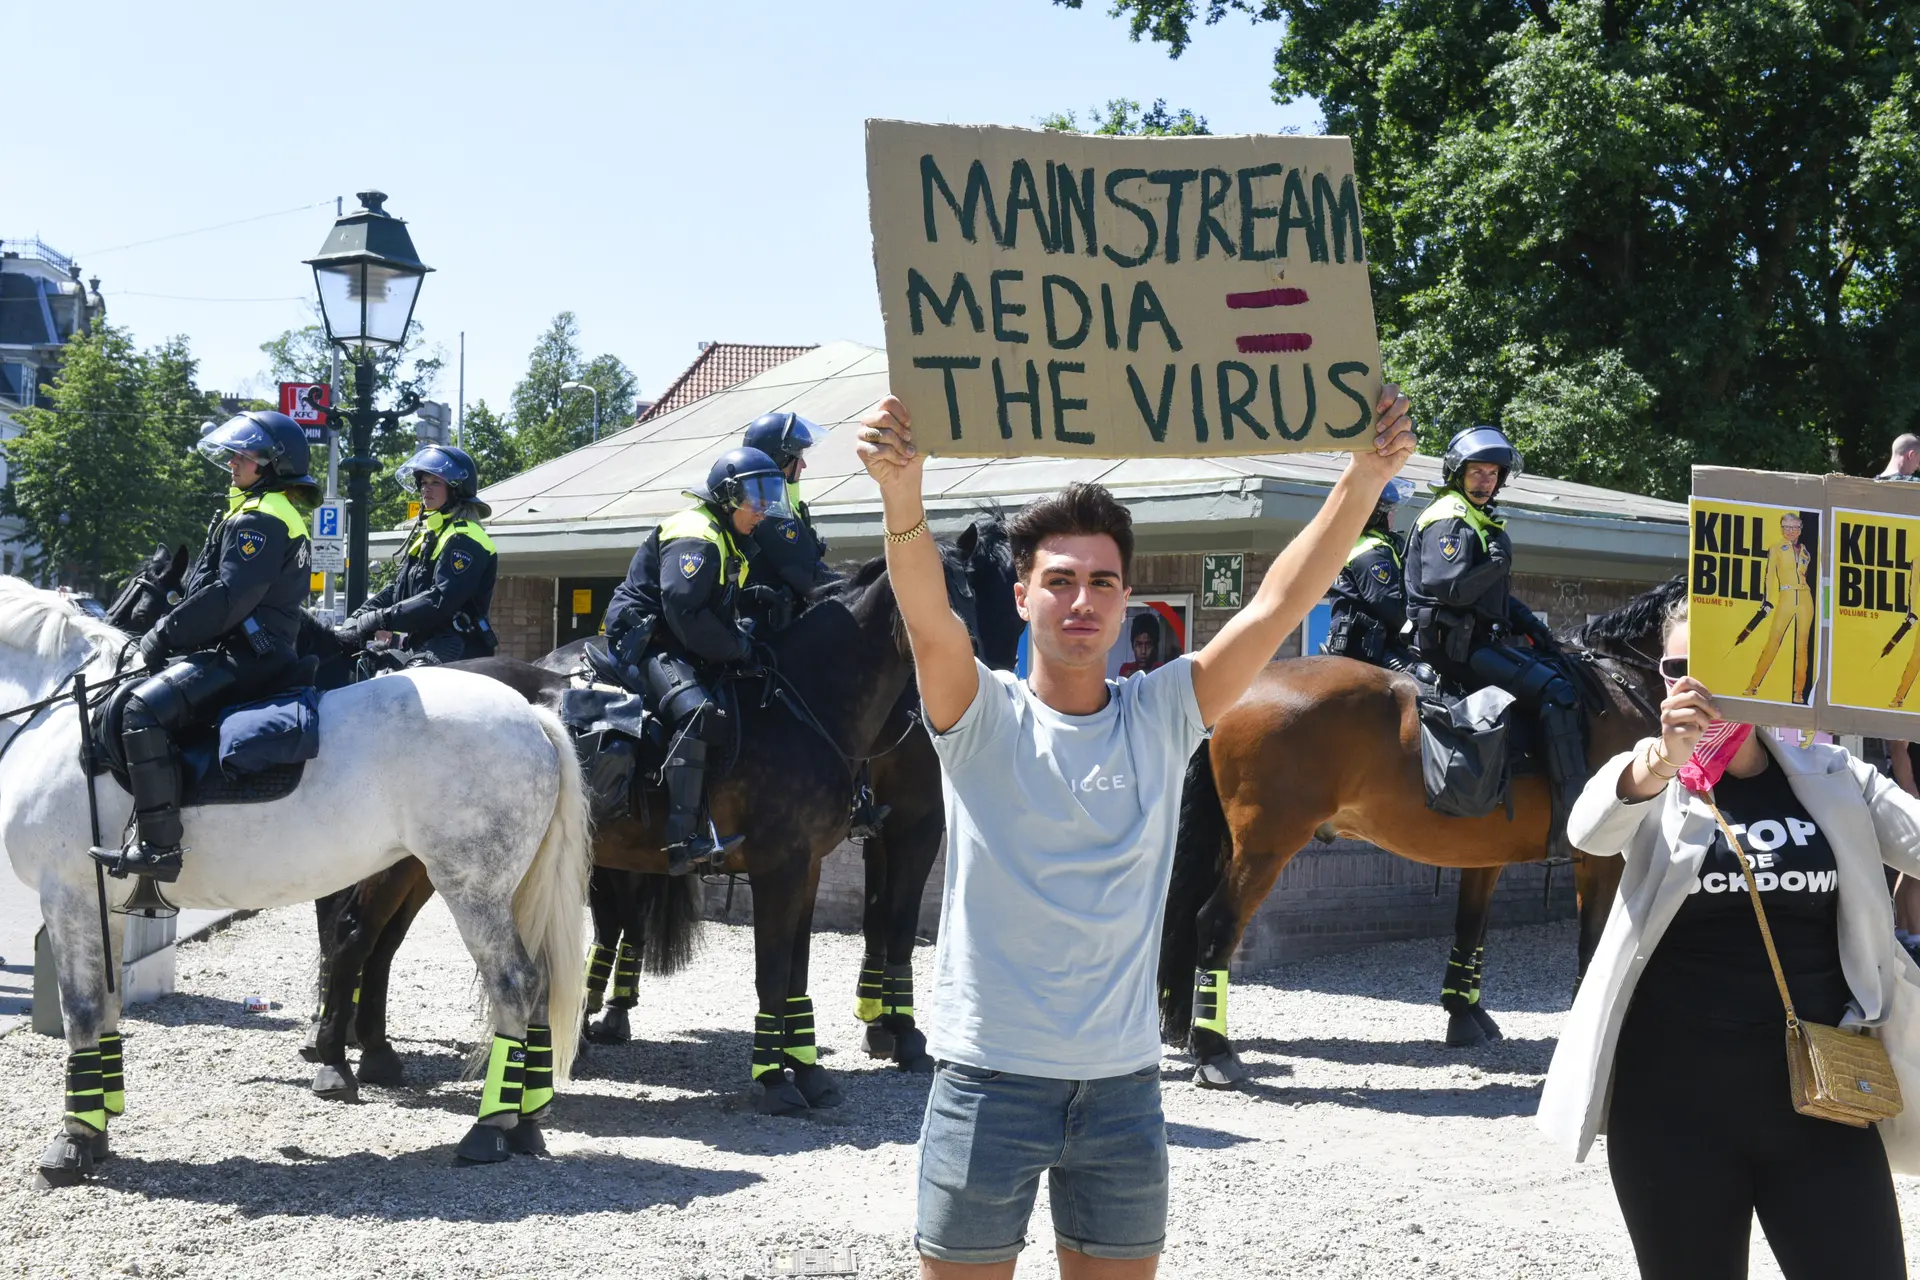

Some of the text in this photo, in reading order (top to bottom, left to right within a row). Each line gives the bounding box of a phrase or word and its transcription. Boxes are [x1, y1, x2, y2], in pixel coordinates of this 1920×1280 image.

[919, 153, 1364, 268] MAINSTREAM
[906, 268, 1183, 353] MEDIA
[294, 411, 314, 419] KFC
[912, 356, 1373, 445] THE VIRUS
[1694, 510, 1770, 558] KILL
[1840, 522, 1912, 570] KILL
[1693, 553, 1766, 602] BILL
[1693, 596, 1723, 606] VOLUME
[1839, 565, 1909, 613] BILL
[1839, 608, 1868, 618] VOLUME
[1071, 774, 1126, 793] ICCE
[1716, 817, 1816, 852] TOP
[1688, 870, 1838, 895] CKDOWN
